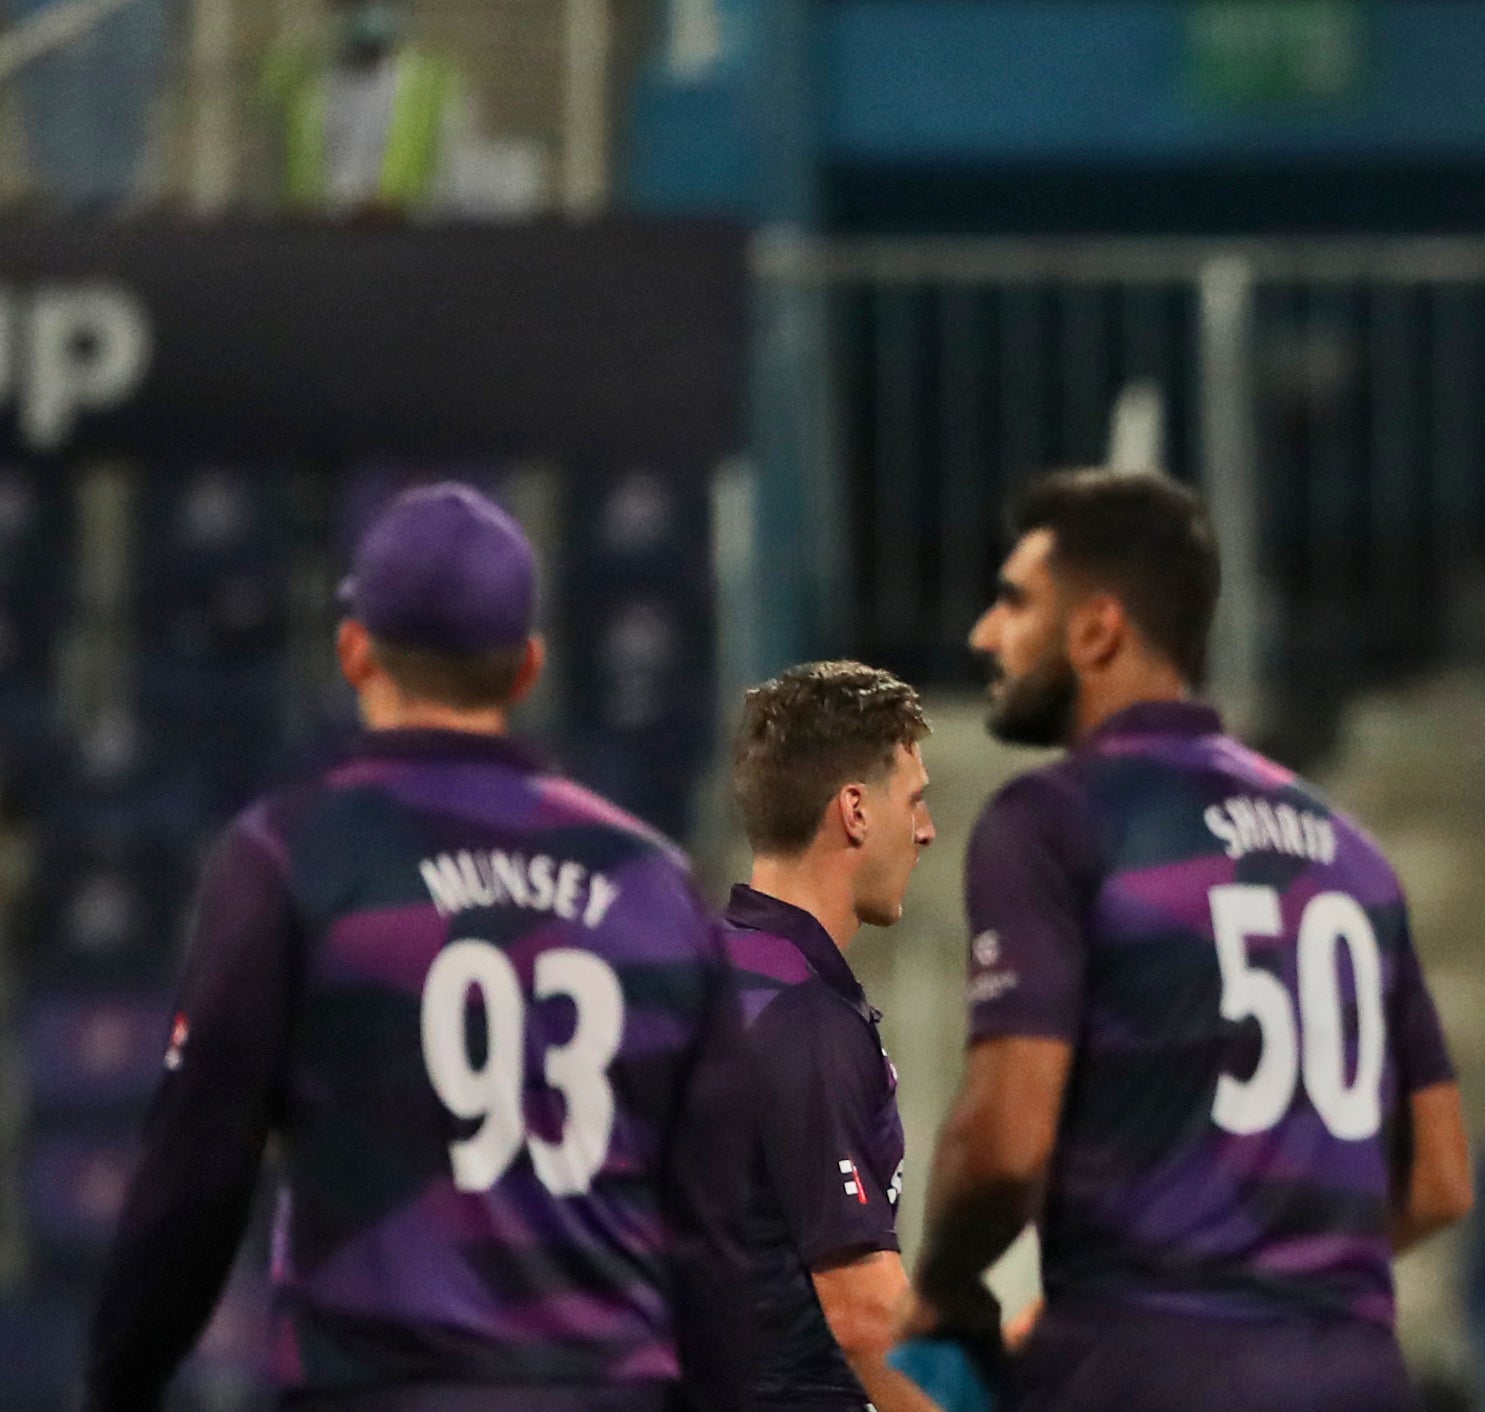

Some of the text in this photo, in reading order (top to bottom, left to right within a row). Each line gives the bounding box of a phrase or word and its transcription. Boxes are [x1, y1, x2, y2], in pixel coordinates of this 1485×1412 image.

[0, 285, 148, 448] p
[419, 849, 622, 928] MUNSEY
[420, 938, 625, 1196] 93
[1208, 882, 1386, 1141] 50
